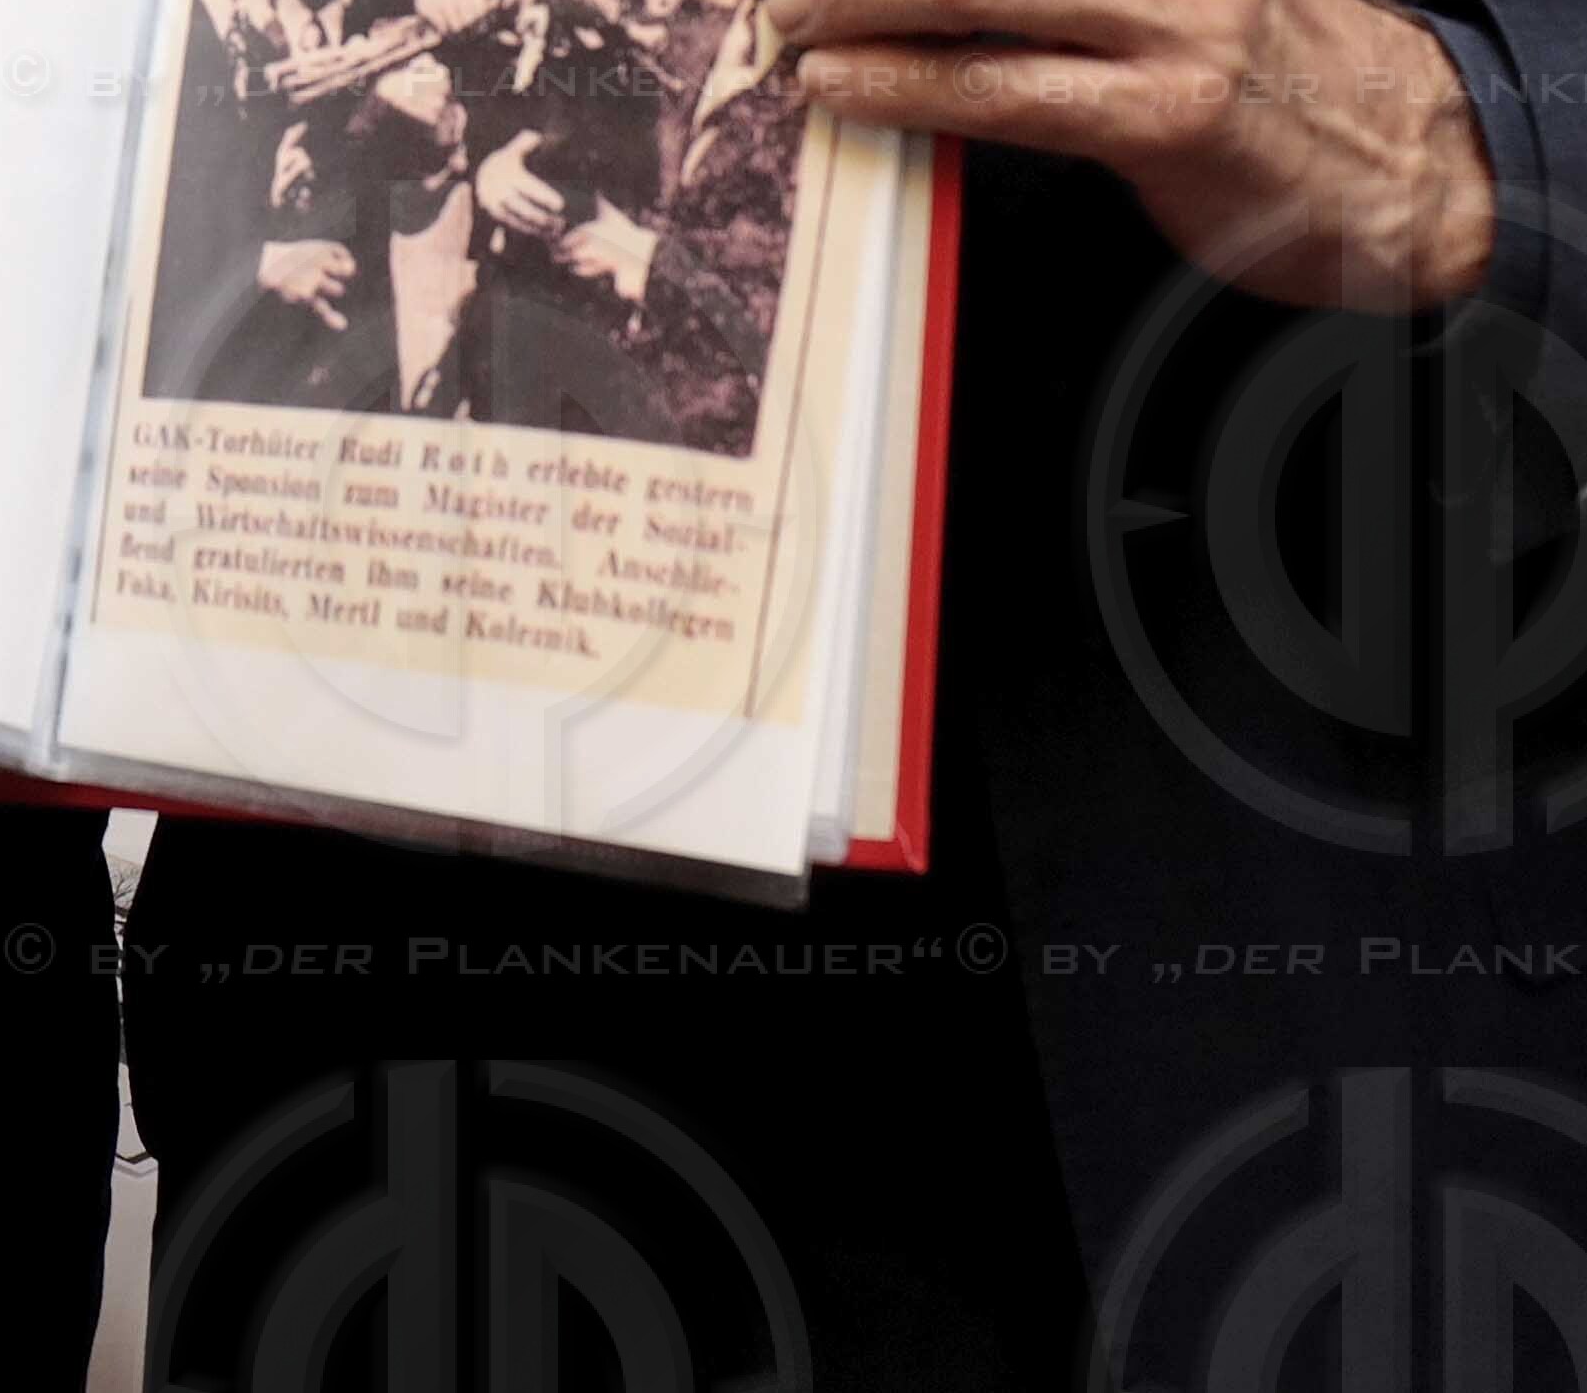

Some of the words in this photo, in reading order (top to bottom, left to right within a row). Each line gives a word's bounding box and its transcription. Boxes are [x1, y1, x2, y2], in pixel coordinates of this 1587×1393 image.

[128, 465, 187, 489] seine
[207, 466, 322, 501] Sponsion
[343, 483, 400, 509] zum
[425, 485, 549, 525] Magister
[572, 500, 622, 536] der
[643, 516, 749, 554] Sozial-
[132, 423, 322, 461] GAK-Torhüter
[339, 436, 402, 467] Rudi
[527, 457, 630, 494] erlebte
[645, 477, 754, 513] gestern
[123, 501, 167, 524] und
[196, 503, 562, 570] Wirtschaftswissenschaften.
[598, 550, 740, 596] Anschlie-
[193, 547, 346, 586] gratulierten
[442, 573, 514, 602] seine
[537, 580, 736, 642] Klubkollegen
[395, 603, 449, 637] und
